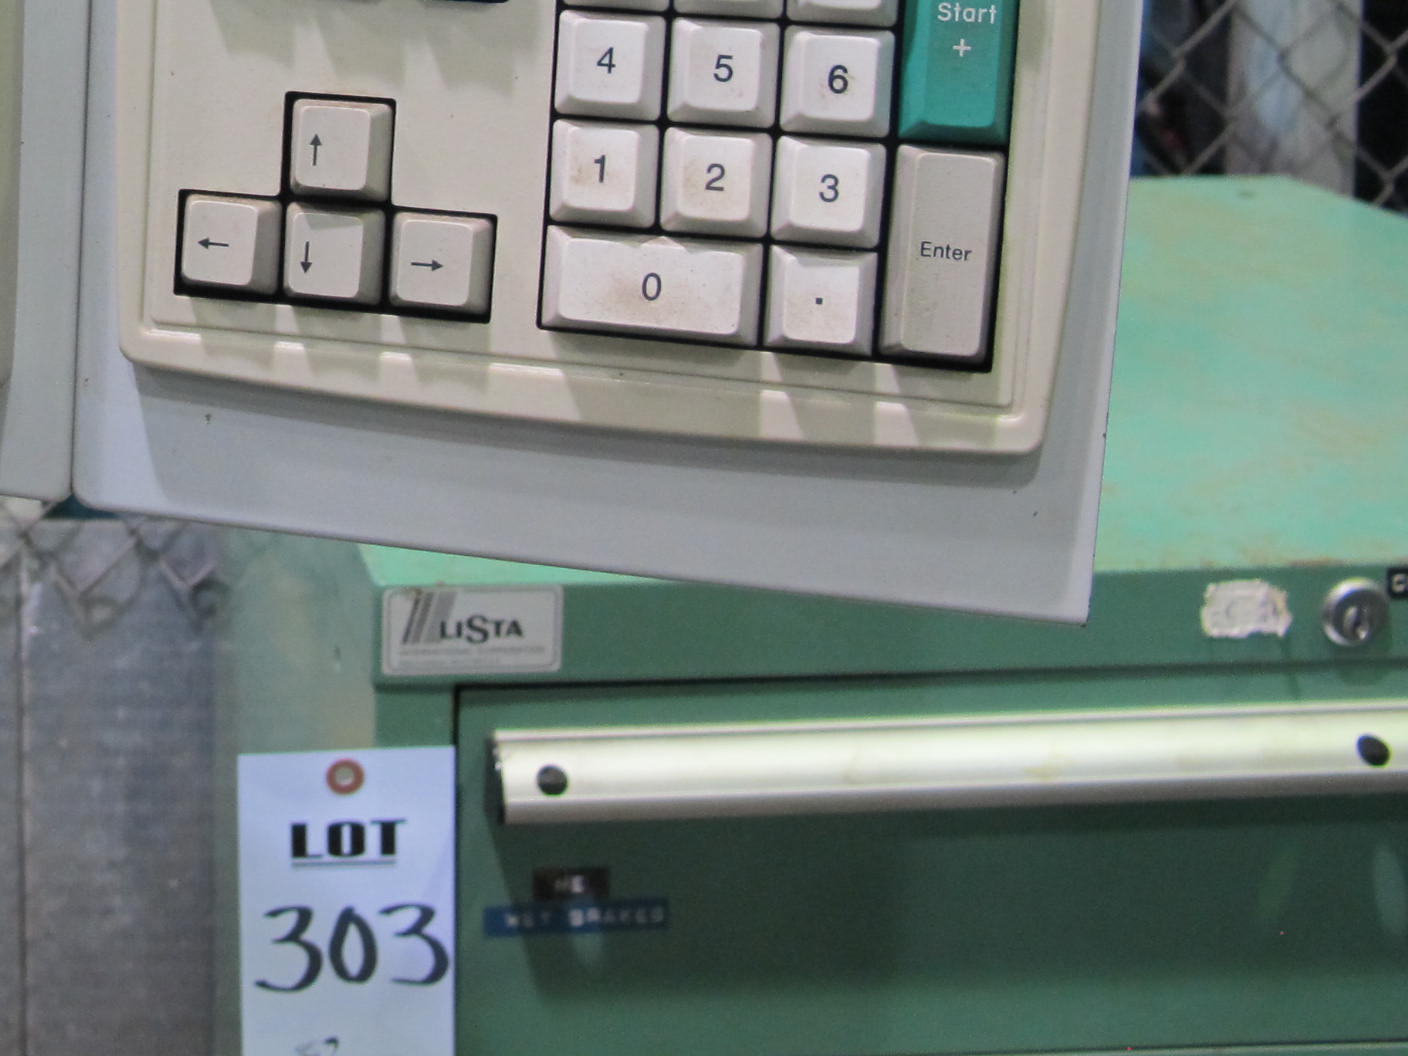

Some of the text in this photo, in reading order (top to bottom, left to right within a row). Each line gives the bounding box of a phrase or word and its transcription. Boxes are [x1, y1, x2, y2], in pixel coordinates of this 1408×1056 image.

[937, 2, 998, 24] Start
[596, 47, 617, 75] 4
[713, 54, 734, 83] 5
[827, 65, 849, 95] 6
[593, 154, 606, 184] 1
[704, 163, 726, 192] 2
[818, 174, 840, 203] 3
[919, 241, 973, 262] Enter
[641, 272, 663, 302] 0
[439, 614, 524, 645] LISTA
[290, 818, 408, 859] LOT
[254, 902, 451, 993] 303
